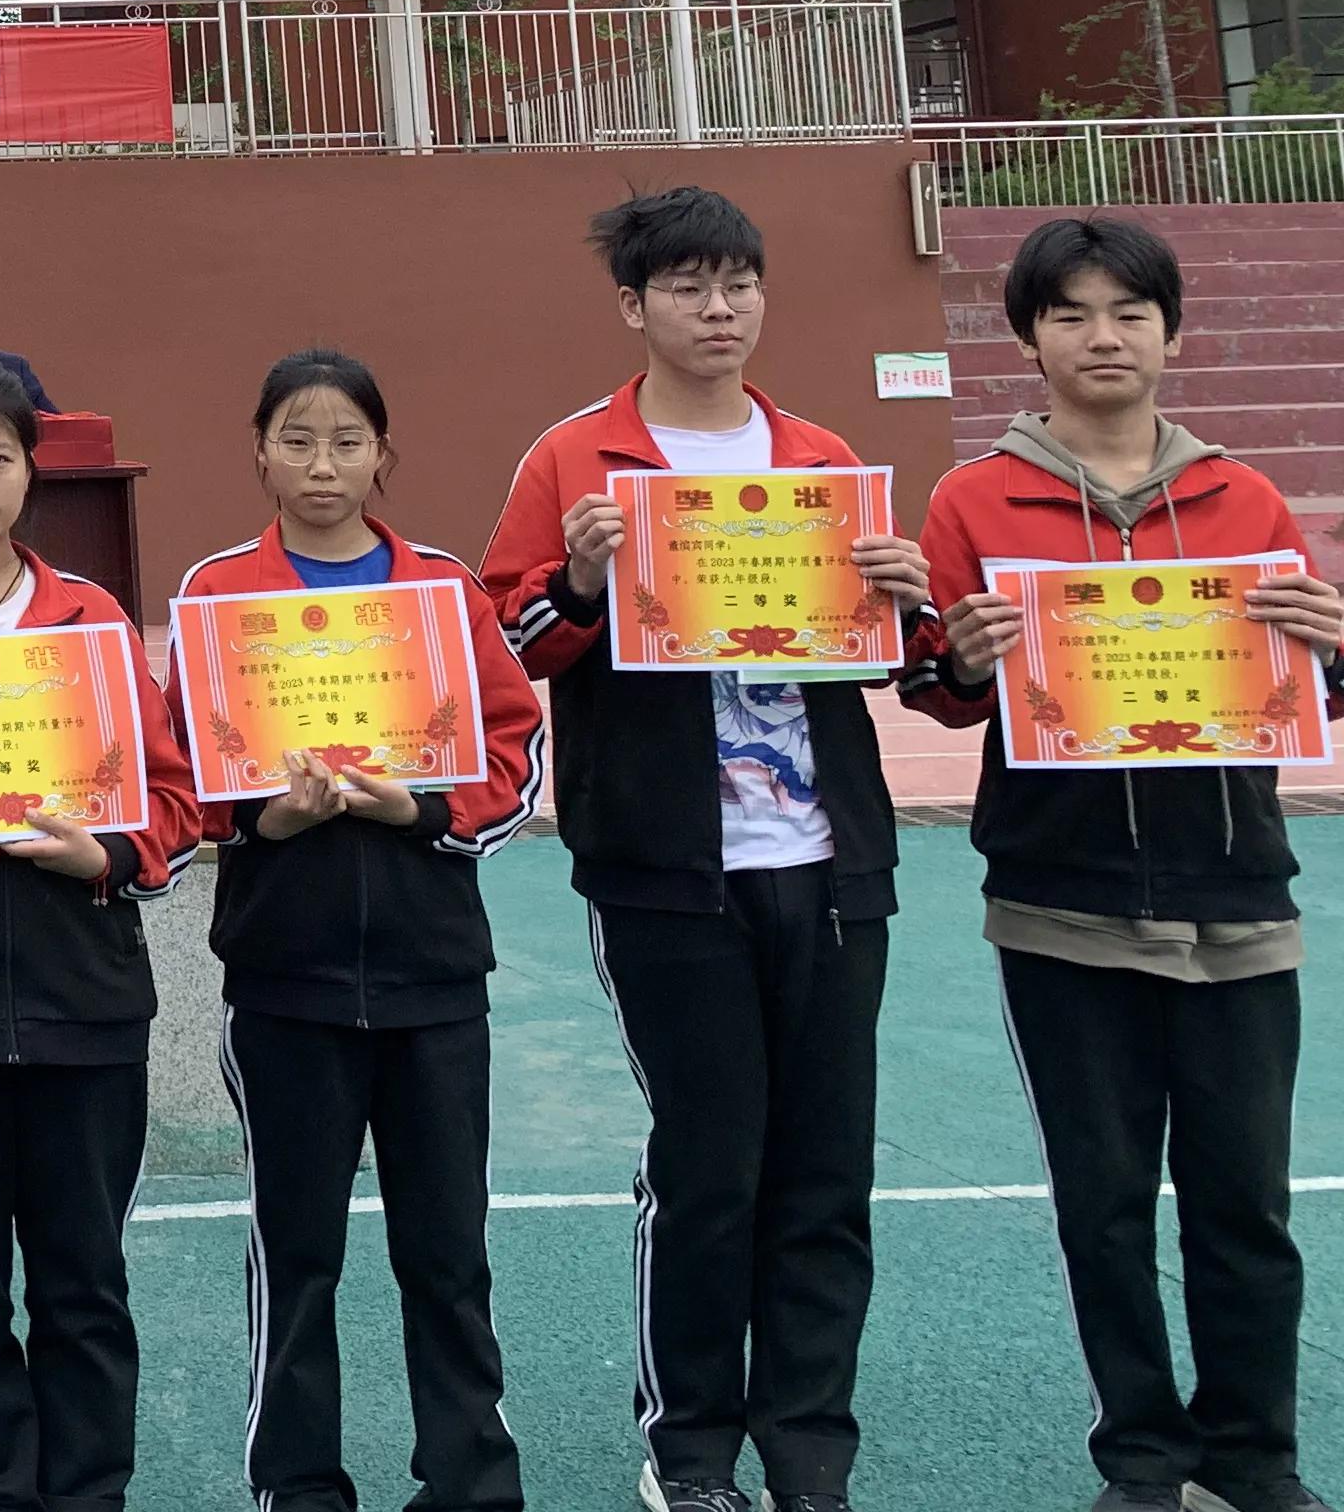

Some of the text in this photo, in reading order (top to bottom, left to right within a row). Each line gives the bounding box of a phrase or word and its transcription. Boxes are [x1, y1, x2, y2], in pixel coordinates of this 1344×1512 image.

[793, 486, 833, 509] 状
[724, 593, 798, 608] 二等奖
[1190, 577, 1233, 601] 状
[354, 602, 395, 627] 状
[23, 645, 63, 670] 状
[1122, 689, 1201, 703] 二等奖
[297, 711, 369, 727] 二等奖
